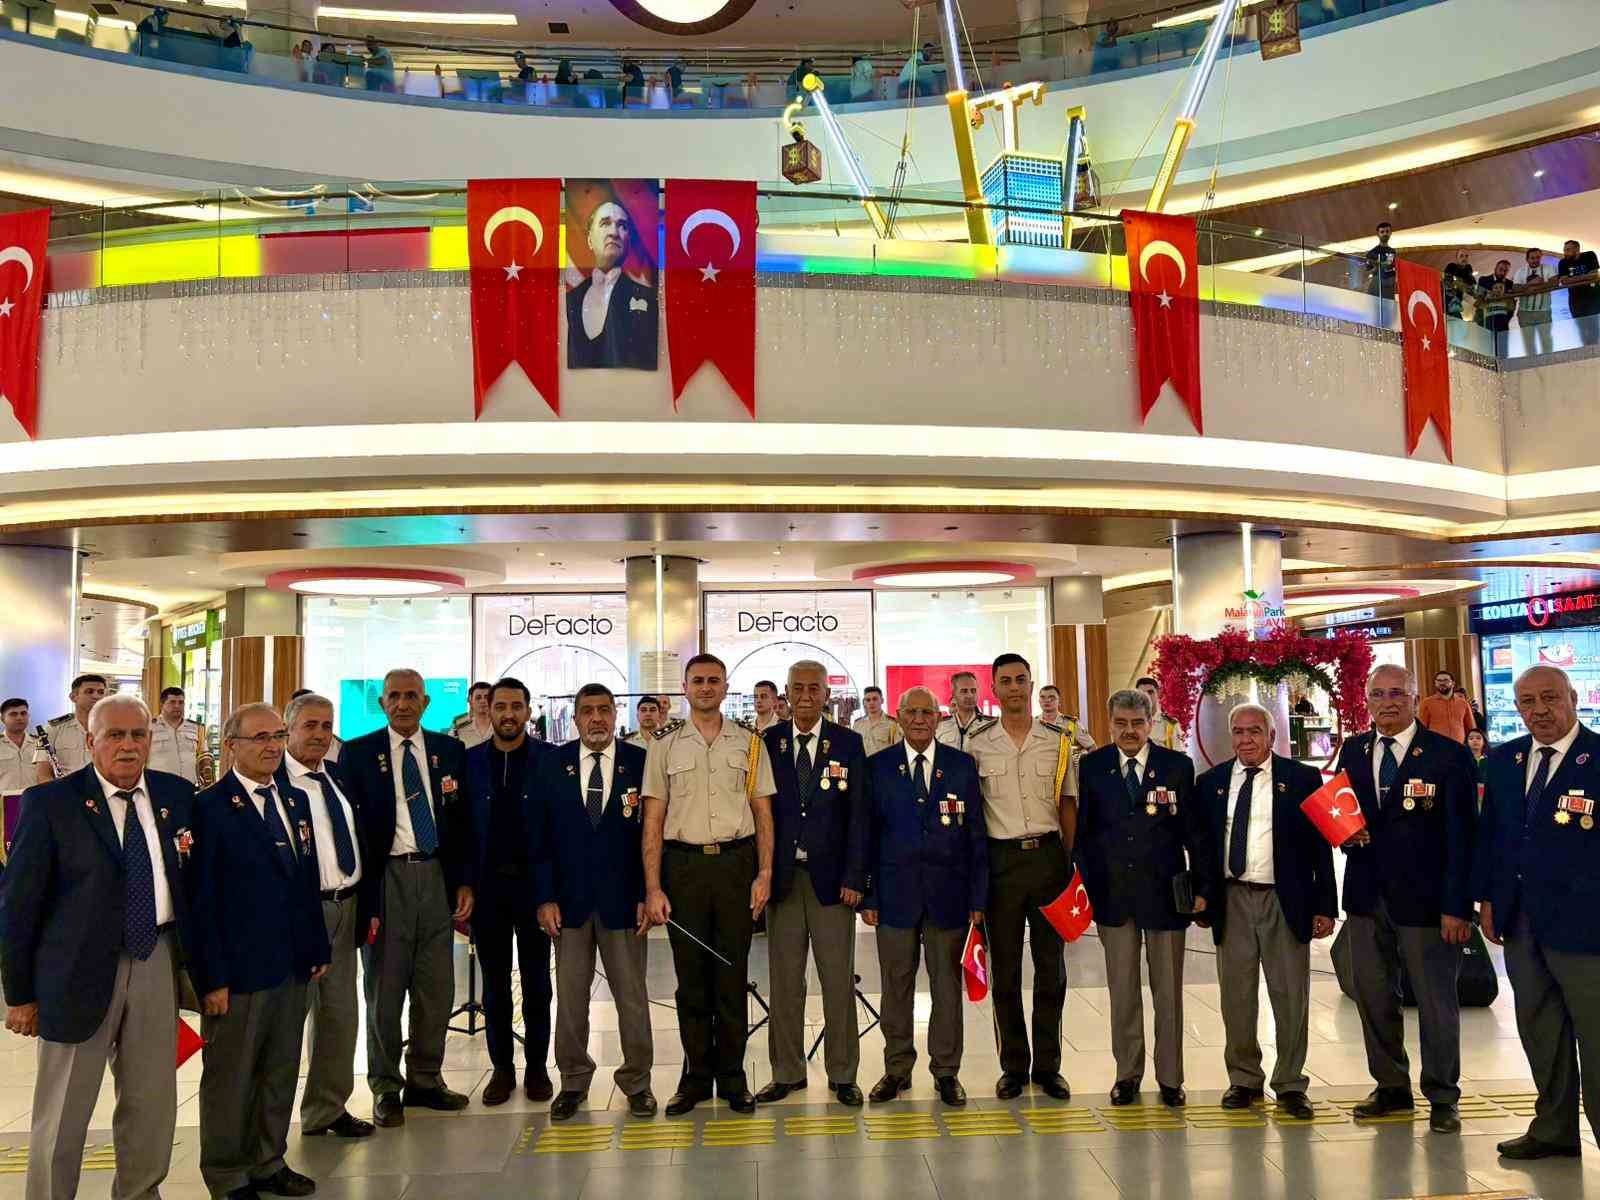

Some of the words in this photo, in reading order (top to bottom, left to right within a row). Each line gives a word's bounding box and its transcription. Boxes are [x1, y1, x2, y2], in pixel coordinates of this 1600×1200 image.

[1554, 594, 1594, 613] SAAT
[509, 613, 613, 636] DeFacto
[738, 611, 839, 632] DeFacto
